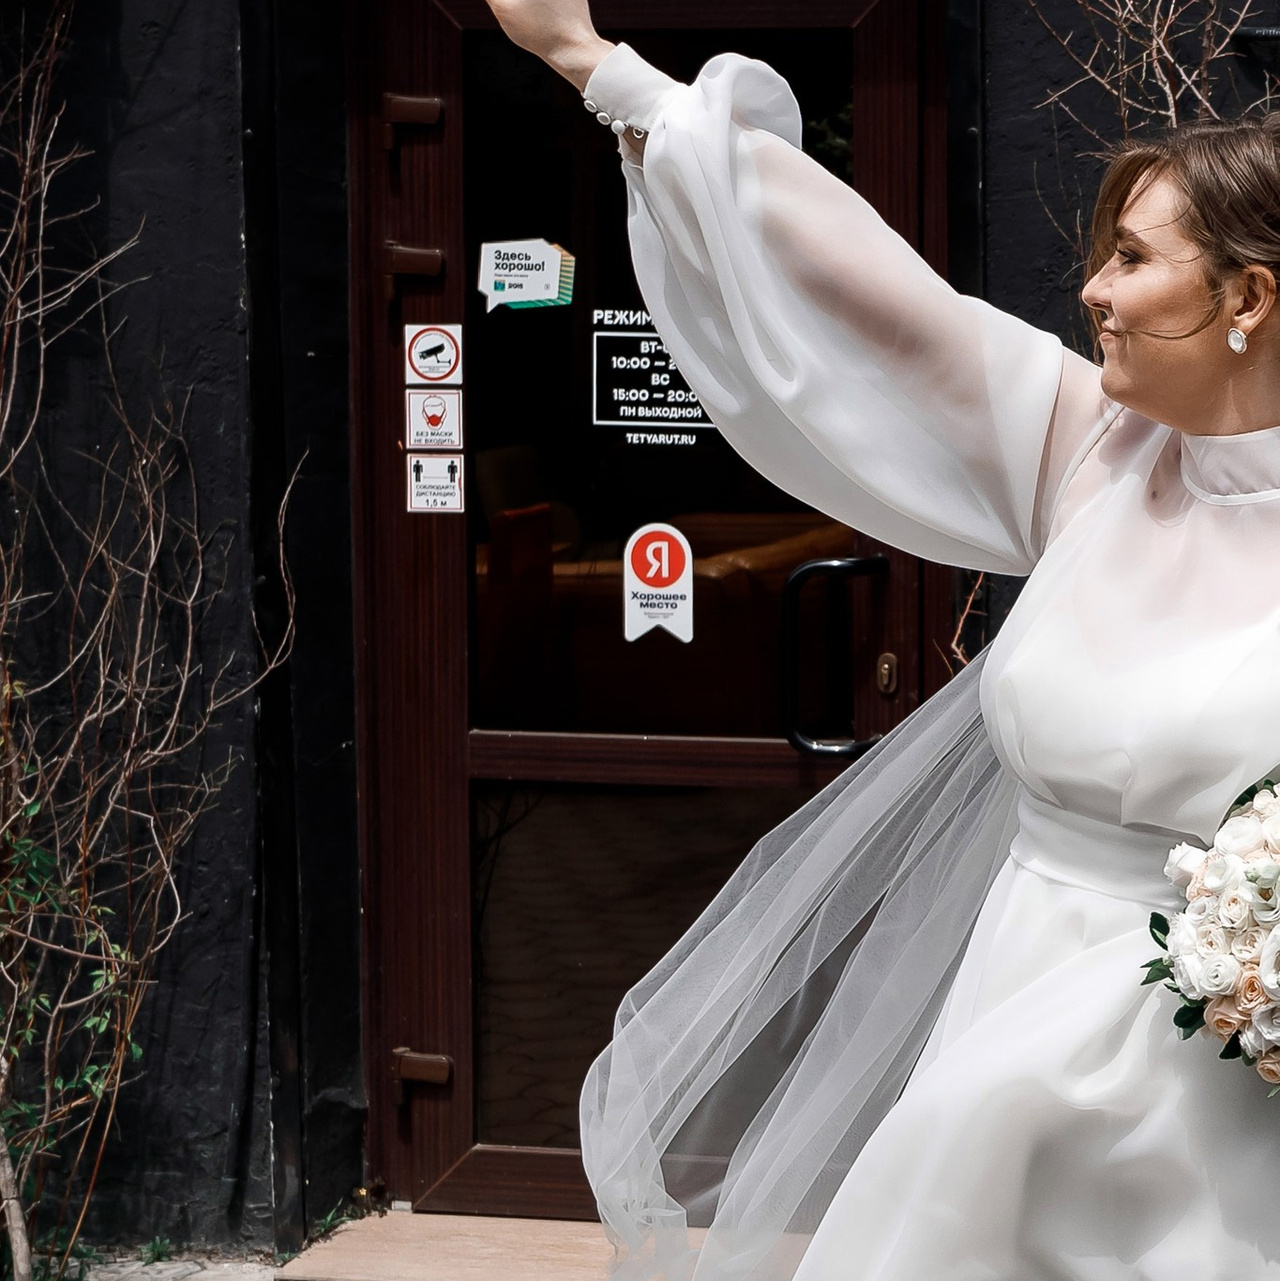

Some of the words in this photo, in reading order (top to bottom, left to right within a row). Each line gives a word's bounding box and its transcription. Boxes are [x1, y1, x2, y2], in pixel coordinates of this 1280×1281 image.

[494, 250, 531, 261] Здесь
[494, 261, 545, 272] хорошо!
[593, 310, 655, 325] РЕЖИМ
[611, 356, 650, 369] 10:00
[651, 373, 670, 386] ВС
[612, 388, 649, 401] 15:00
[667, 390, 698, 403] 20:0
[620, 406, 636, 417] ПН
[637, 406, 703, 419] ВЫХОДНОЙ
[626, 433, 696, 445] TETYARUT.RU
[425, 499, 438, 507] 1,5
[646, 541, 669, 578] Я
[631, 591, 687, 602] Хорошее
[640, 601, 678, 610] место
